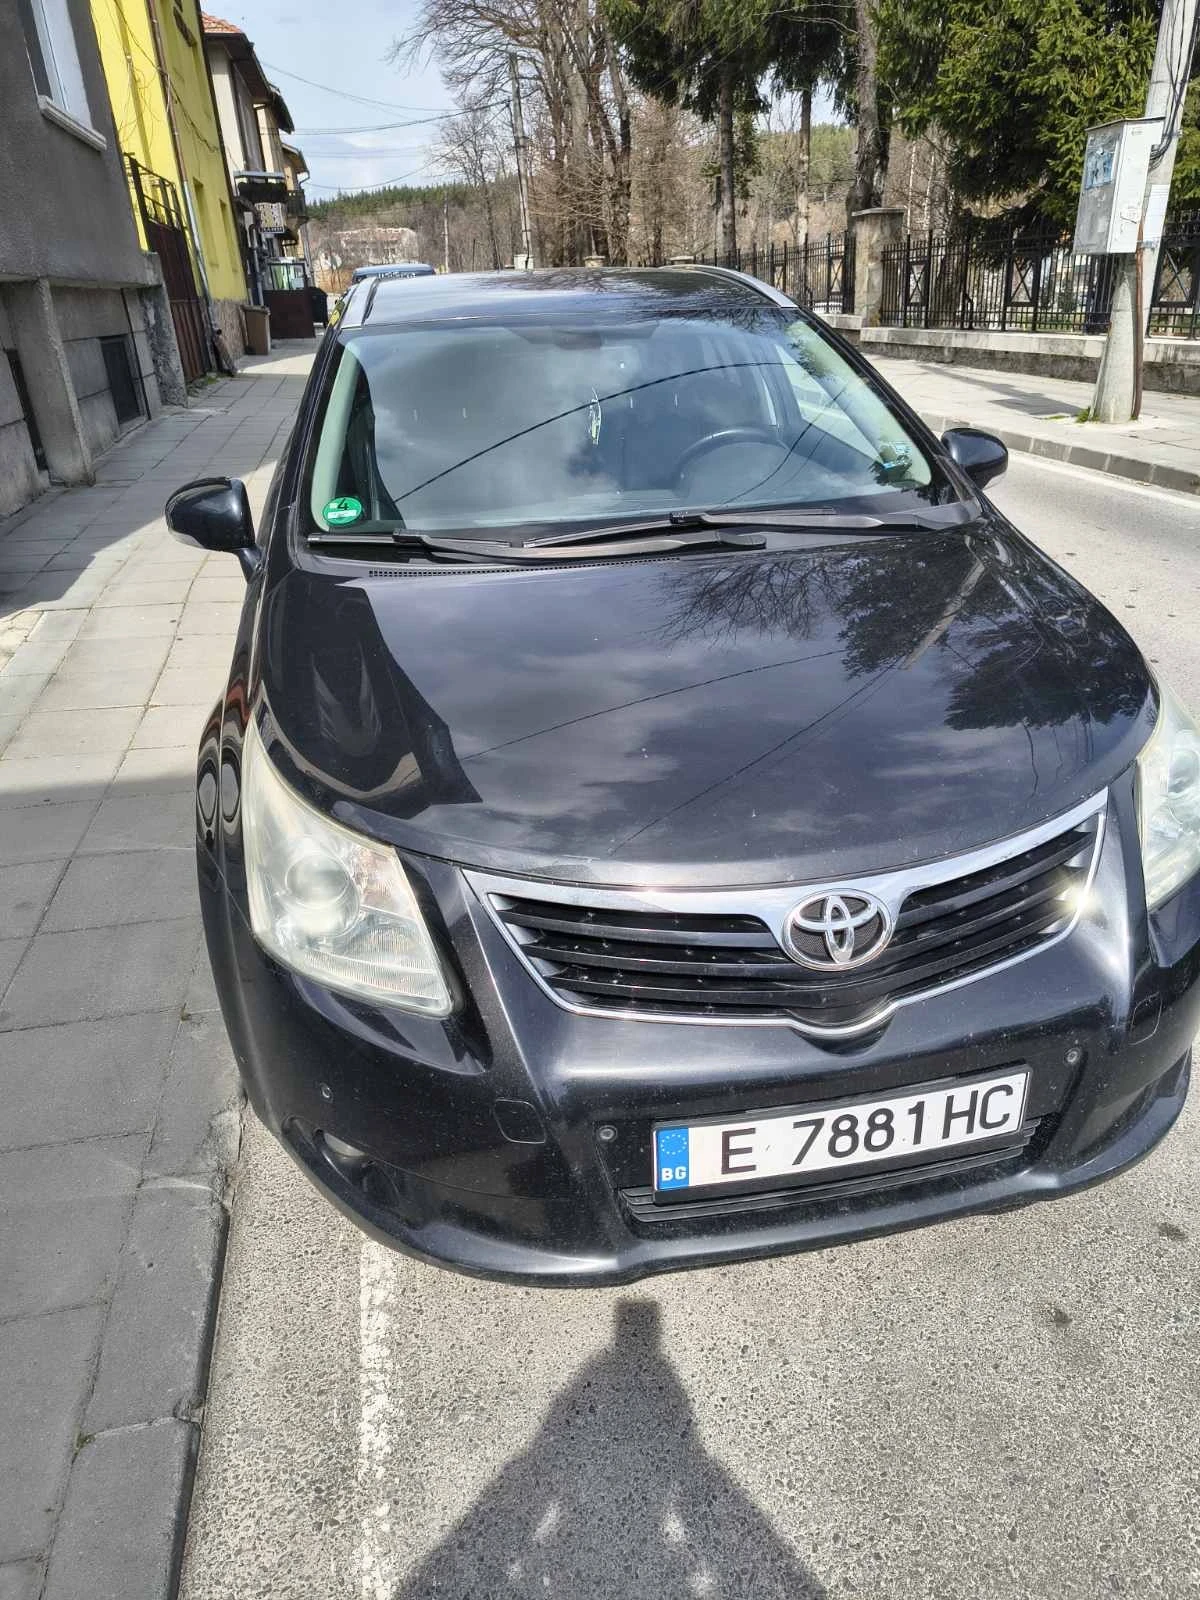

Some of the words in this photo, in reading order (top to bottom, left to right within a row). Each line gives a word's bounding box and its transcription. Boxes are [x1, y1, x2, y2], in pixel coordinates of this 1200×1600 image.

[337, 498, 350, 511] 4
[721, 1127, 756, 1175] E
[661, 1166, 687, 1181] BG
